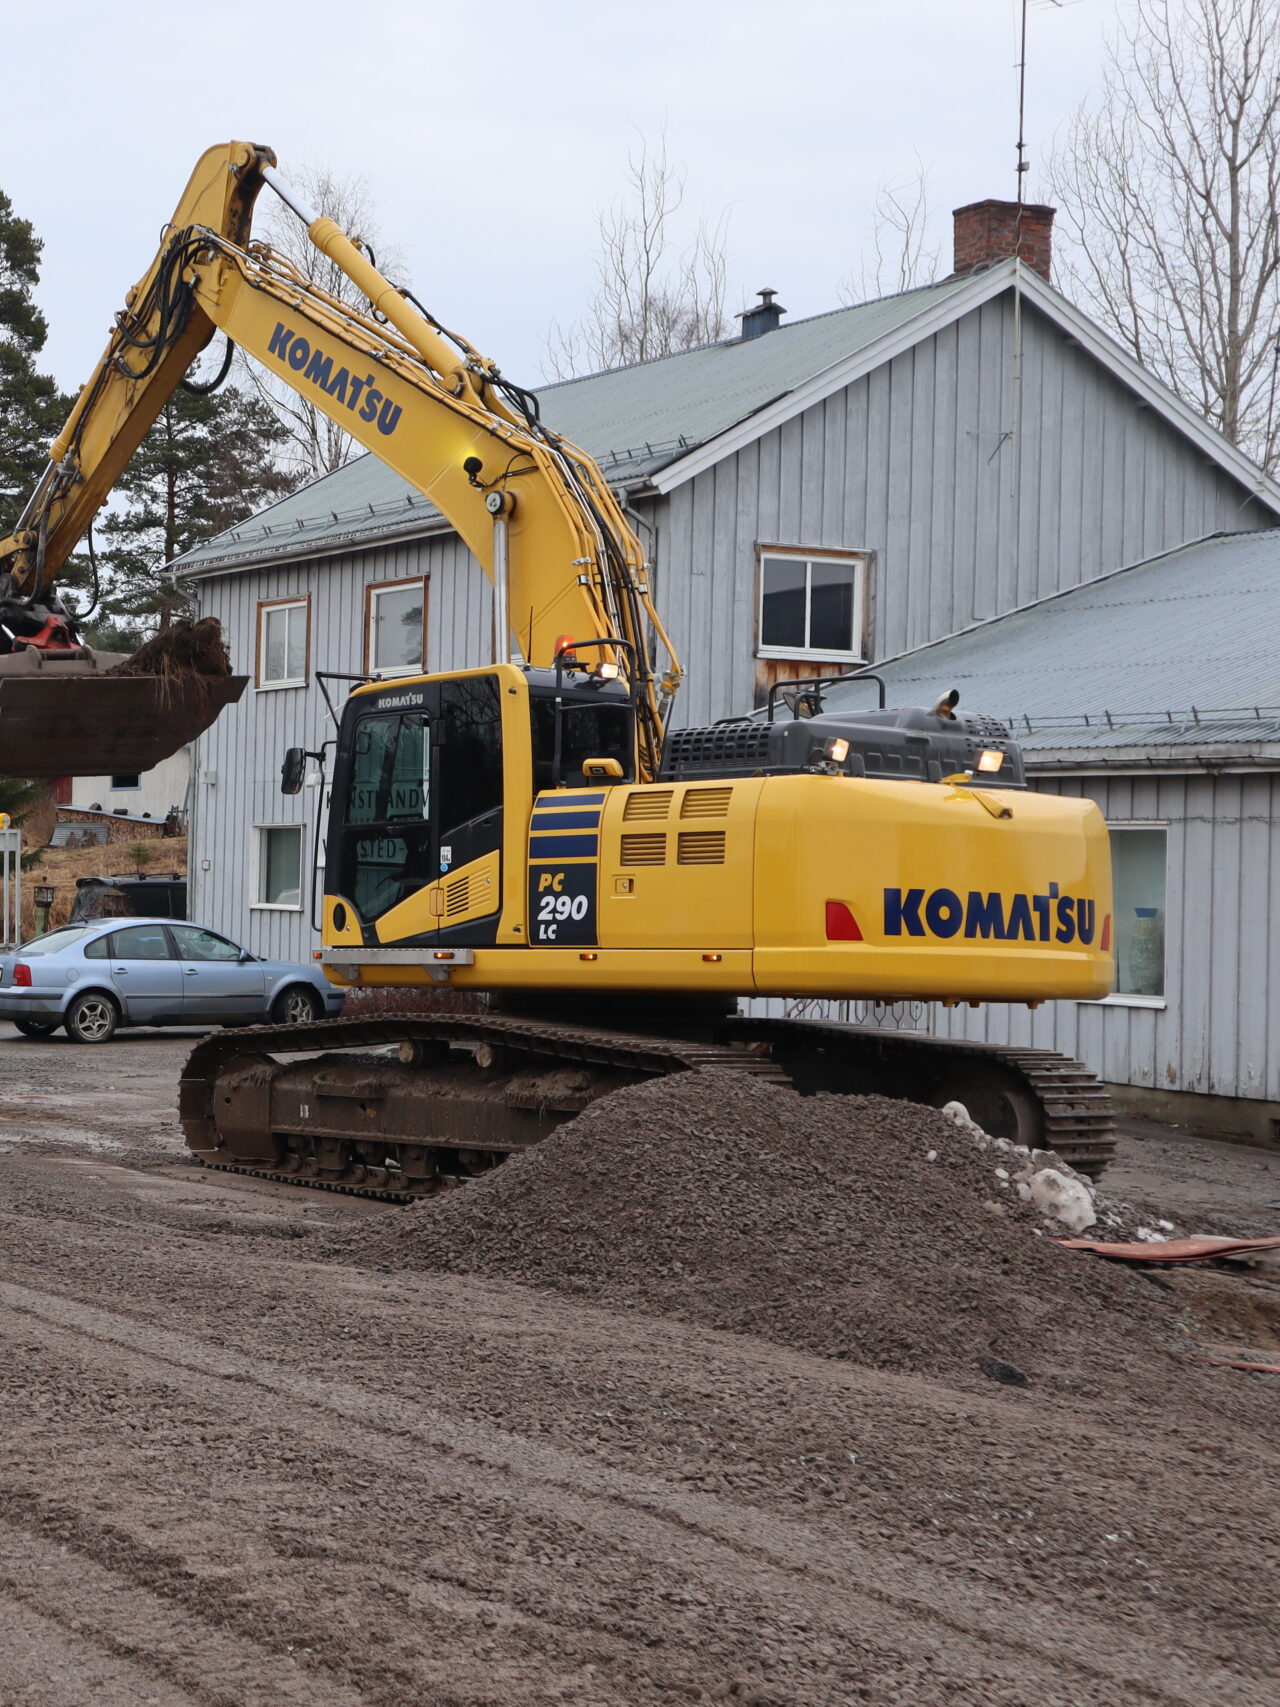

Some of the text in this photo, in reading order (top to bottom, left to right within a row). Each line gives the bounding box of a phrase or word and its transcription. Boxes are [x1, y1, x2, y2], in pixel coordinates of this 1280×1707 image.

[267, 321, 403, 436] KOMATSU
[378, 692, 424, 709] KOMATSU
[538, 872, 565, 892] PC
[537, 894, 589, 921] 290
[883, 881, 1095, 945] KOMATSU
[538, 923, 558, 940] LC
